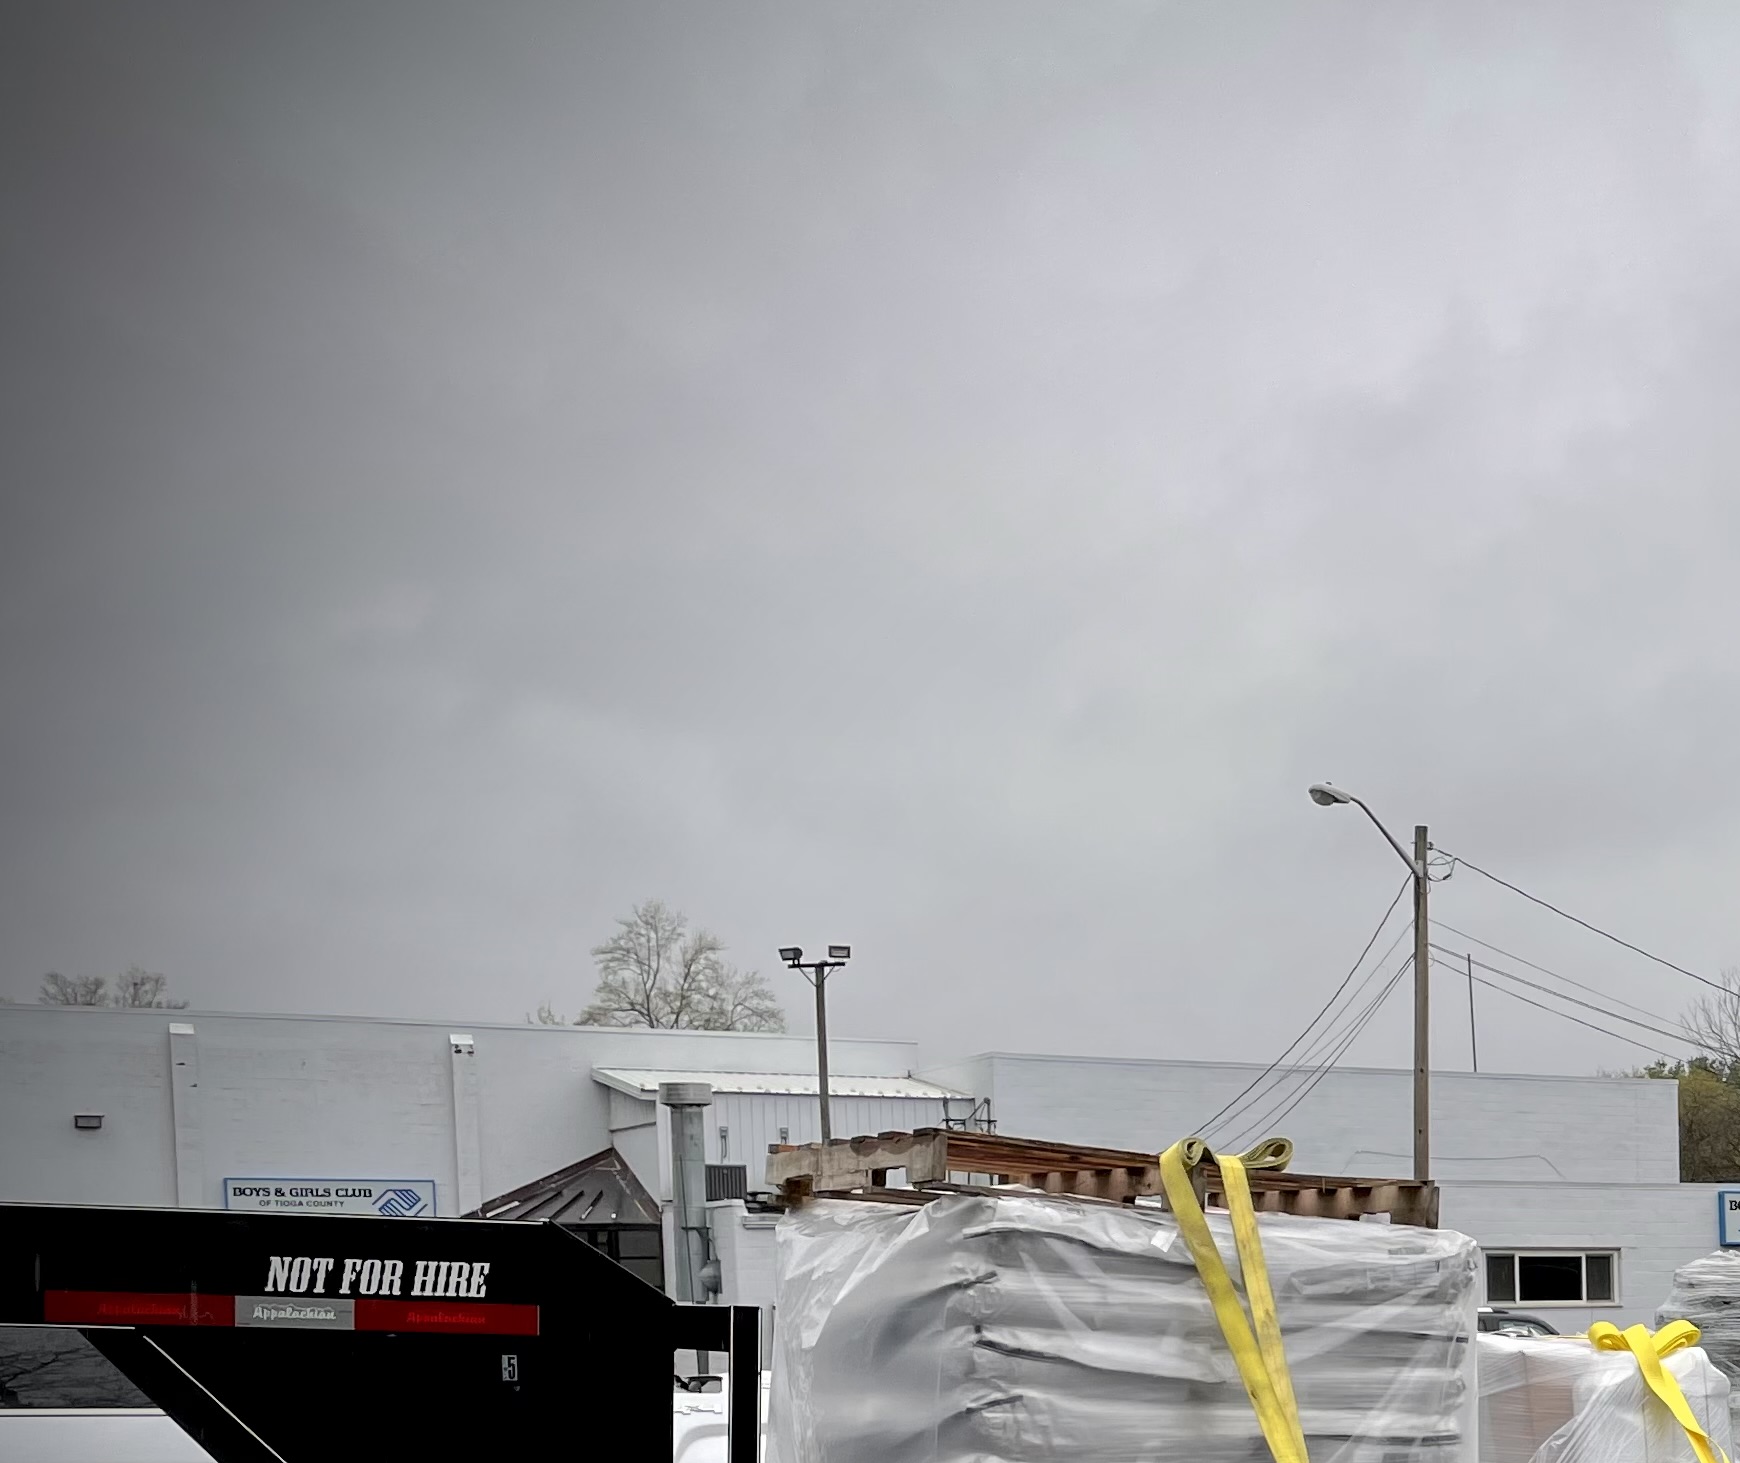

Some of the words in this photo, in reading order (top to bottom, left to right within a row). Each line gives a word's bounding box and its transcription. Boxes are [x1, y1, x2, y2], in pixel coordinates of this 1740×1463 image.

[232, 1186, 271, 1198] BOYS
[274, 1187, 285, 1198] &
[289, 1187, 331, 1199] GIRLS
[335, 1188, 373, 1199] CLUB
[258, 1199, 272, 1208] OF
[274, 1200, 304, 1208] TIOGA
[306, 1200, 345, 1209] COUNTY
[264, 1255, 334, 1294] NOT
[338, 1257, 404, 1296] FOR
[410, 1260, 491, 1298] HIRE
[252, 1304, 337, 1321] Appalachian
